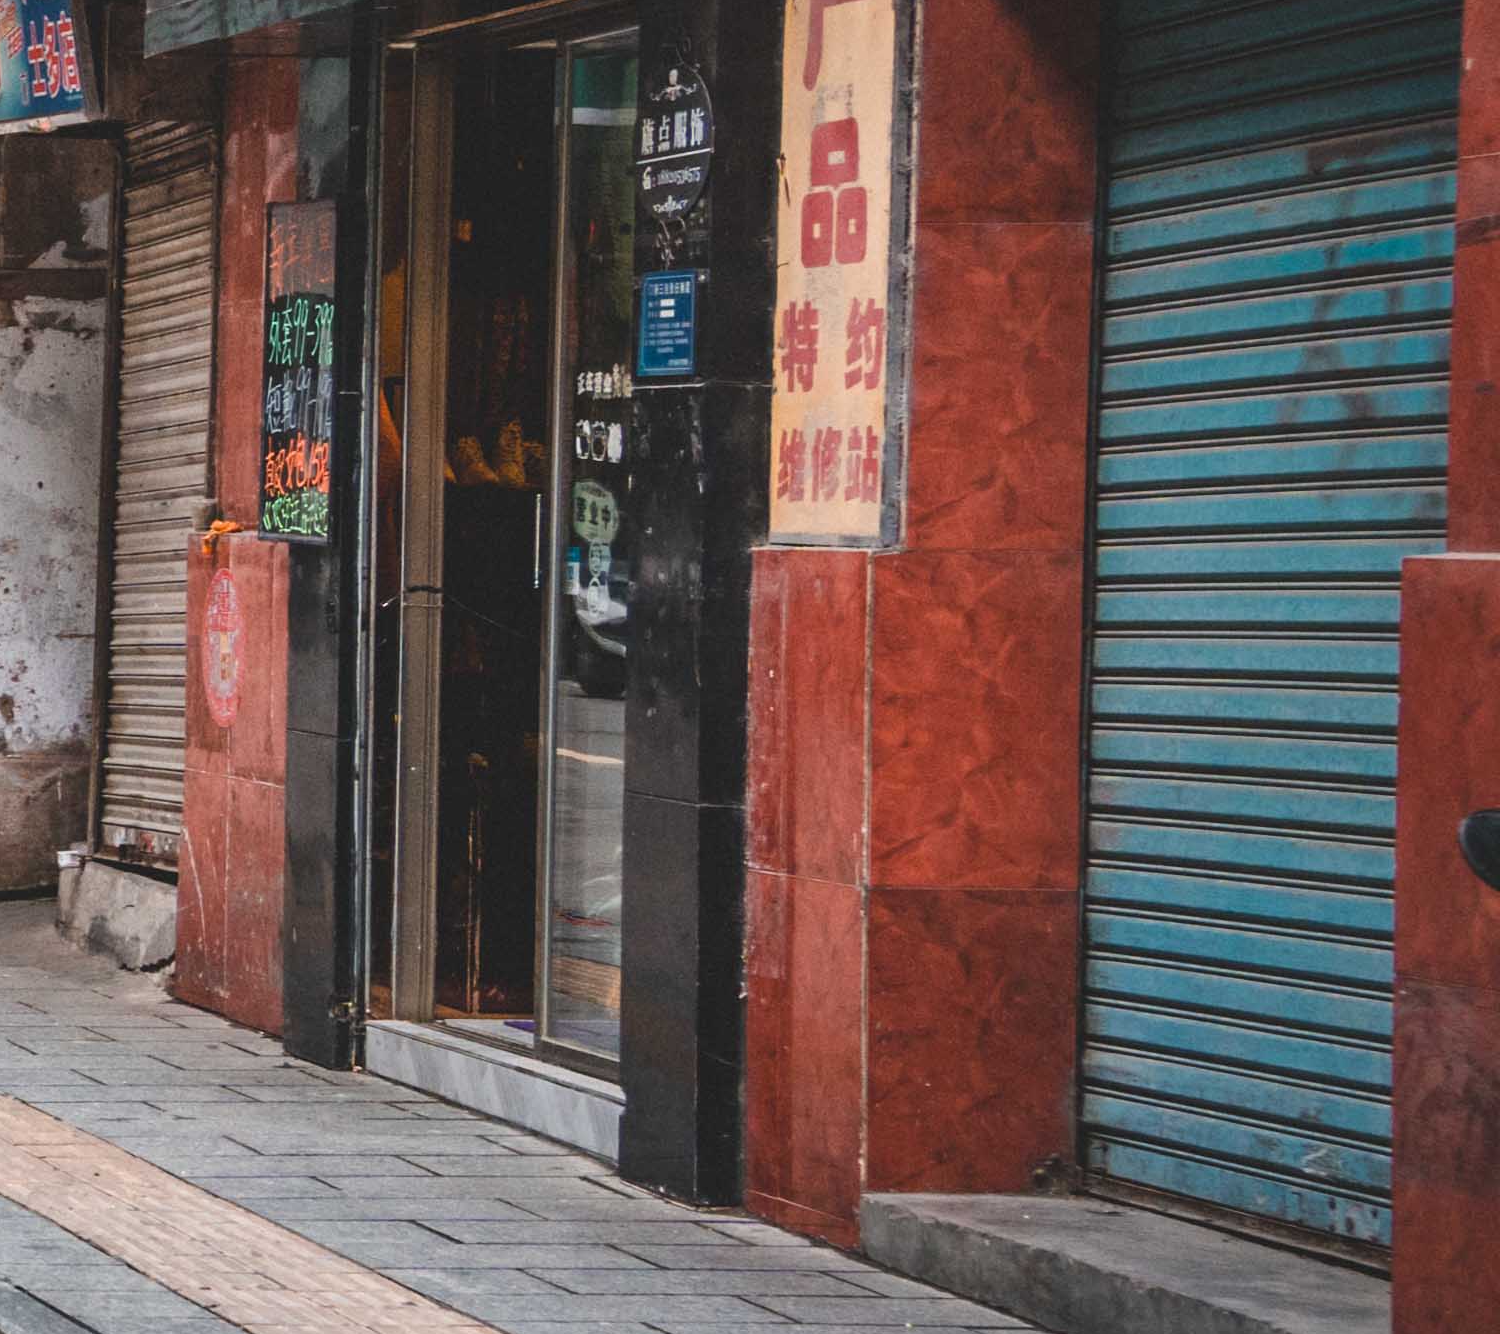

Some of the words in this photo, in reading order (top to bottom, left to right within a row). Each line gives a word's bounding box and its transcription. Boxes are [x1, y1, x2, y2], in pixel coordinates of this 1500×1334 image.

[779, 298, 885, 393] 特约
[775, 424, 880, 505] 维修站
